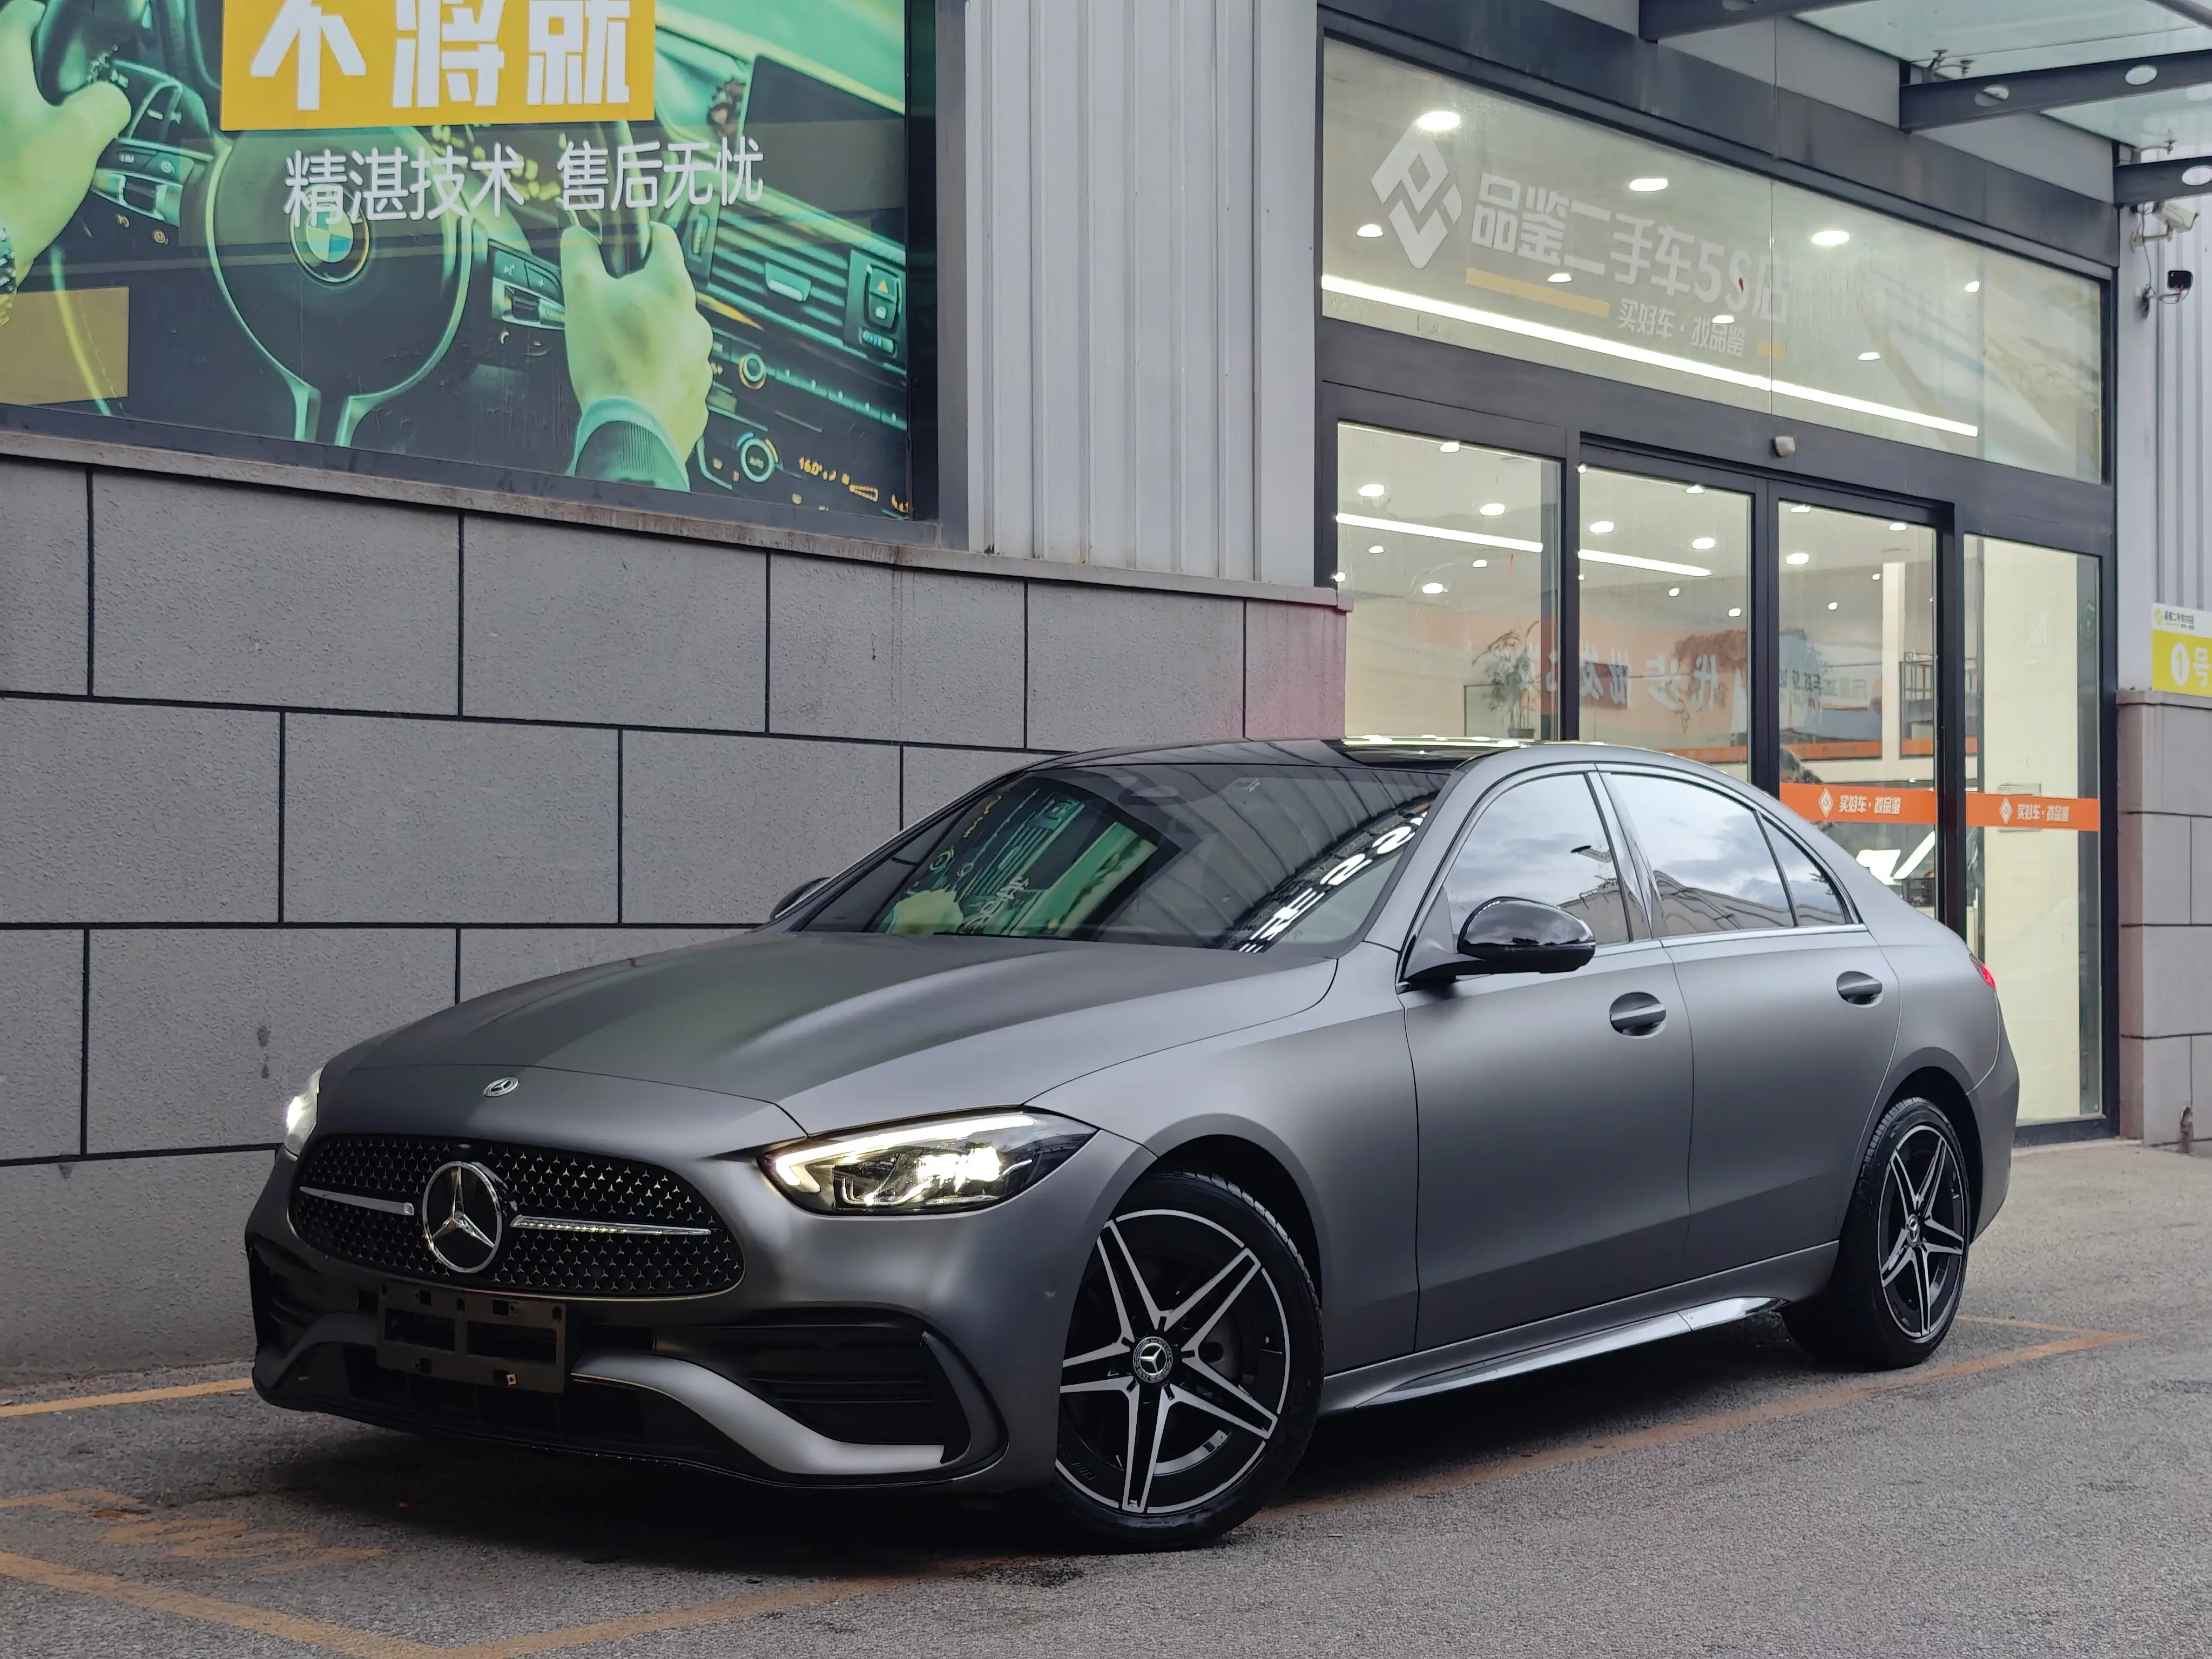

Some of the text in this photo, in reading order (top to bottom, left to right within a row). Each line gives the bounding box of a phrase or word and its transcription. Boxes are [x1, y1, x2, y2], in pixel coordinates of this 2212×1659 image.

[284, 136, 764, 227] 精湛技术 售后无忧
[1471, 171, 1789, 322] 品鉴二手车5S店
